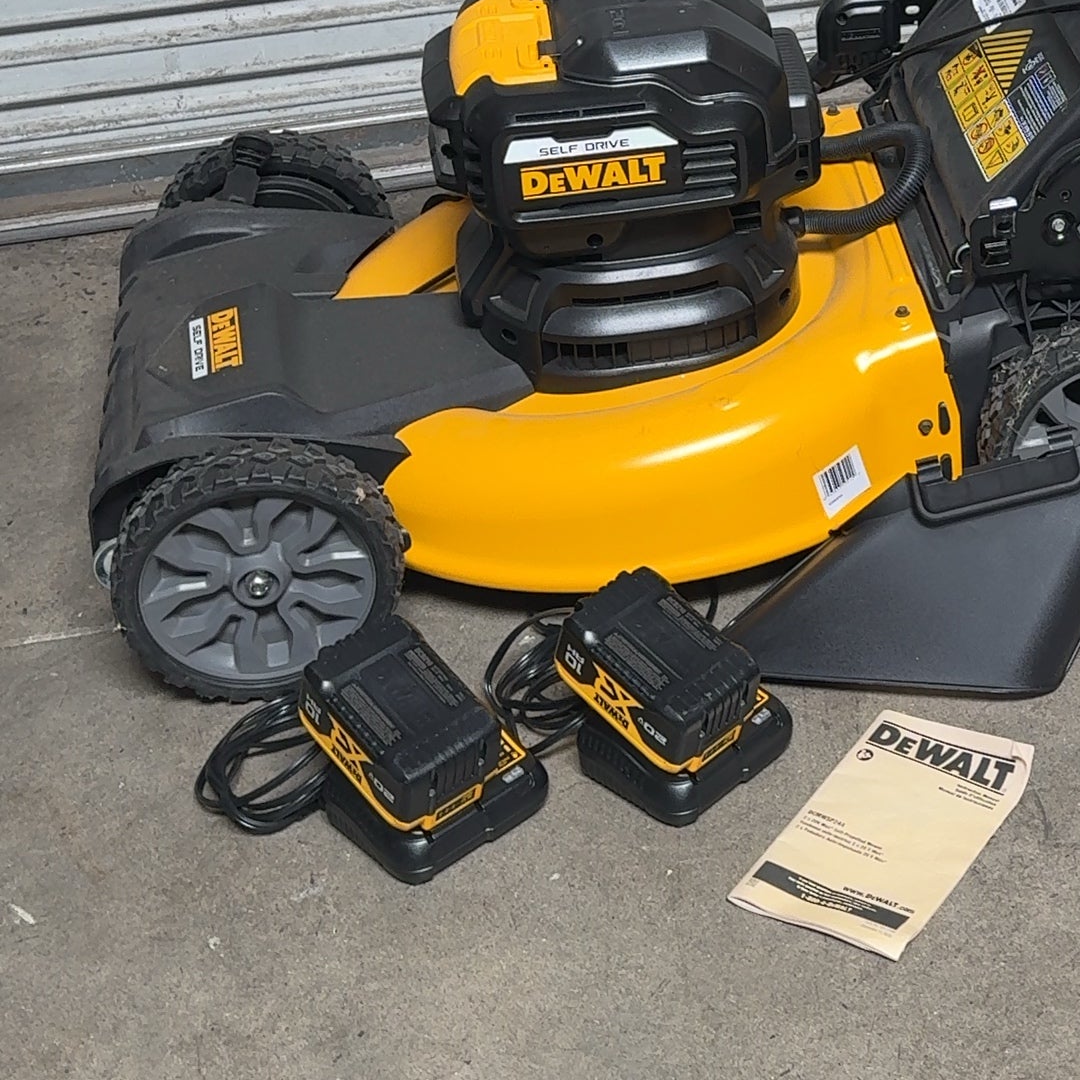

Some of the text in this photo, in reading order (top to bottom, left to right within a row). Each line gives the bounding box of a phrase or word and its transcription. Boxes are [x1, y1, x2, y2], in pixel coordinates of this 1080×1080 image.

[539, 138, 630, 157] SELF DRIVE
[521, 156, 666, 197] DEWALT
[868, 722, 1016, 792] DEWALT
